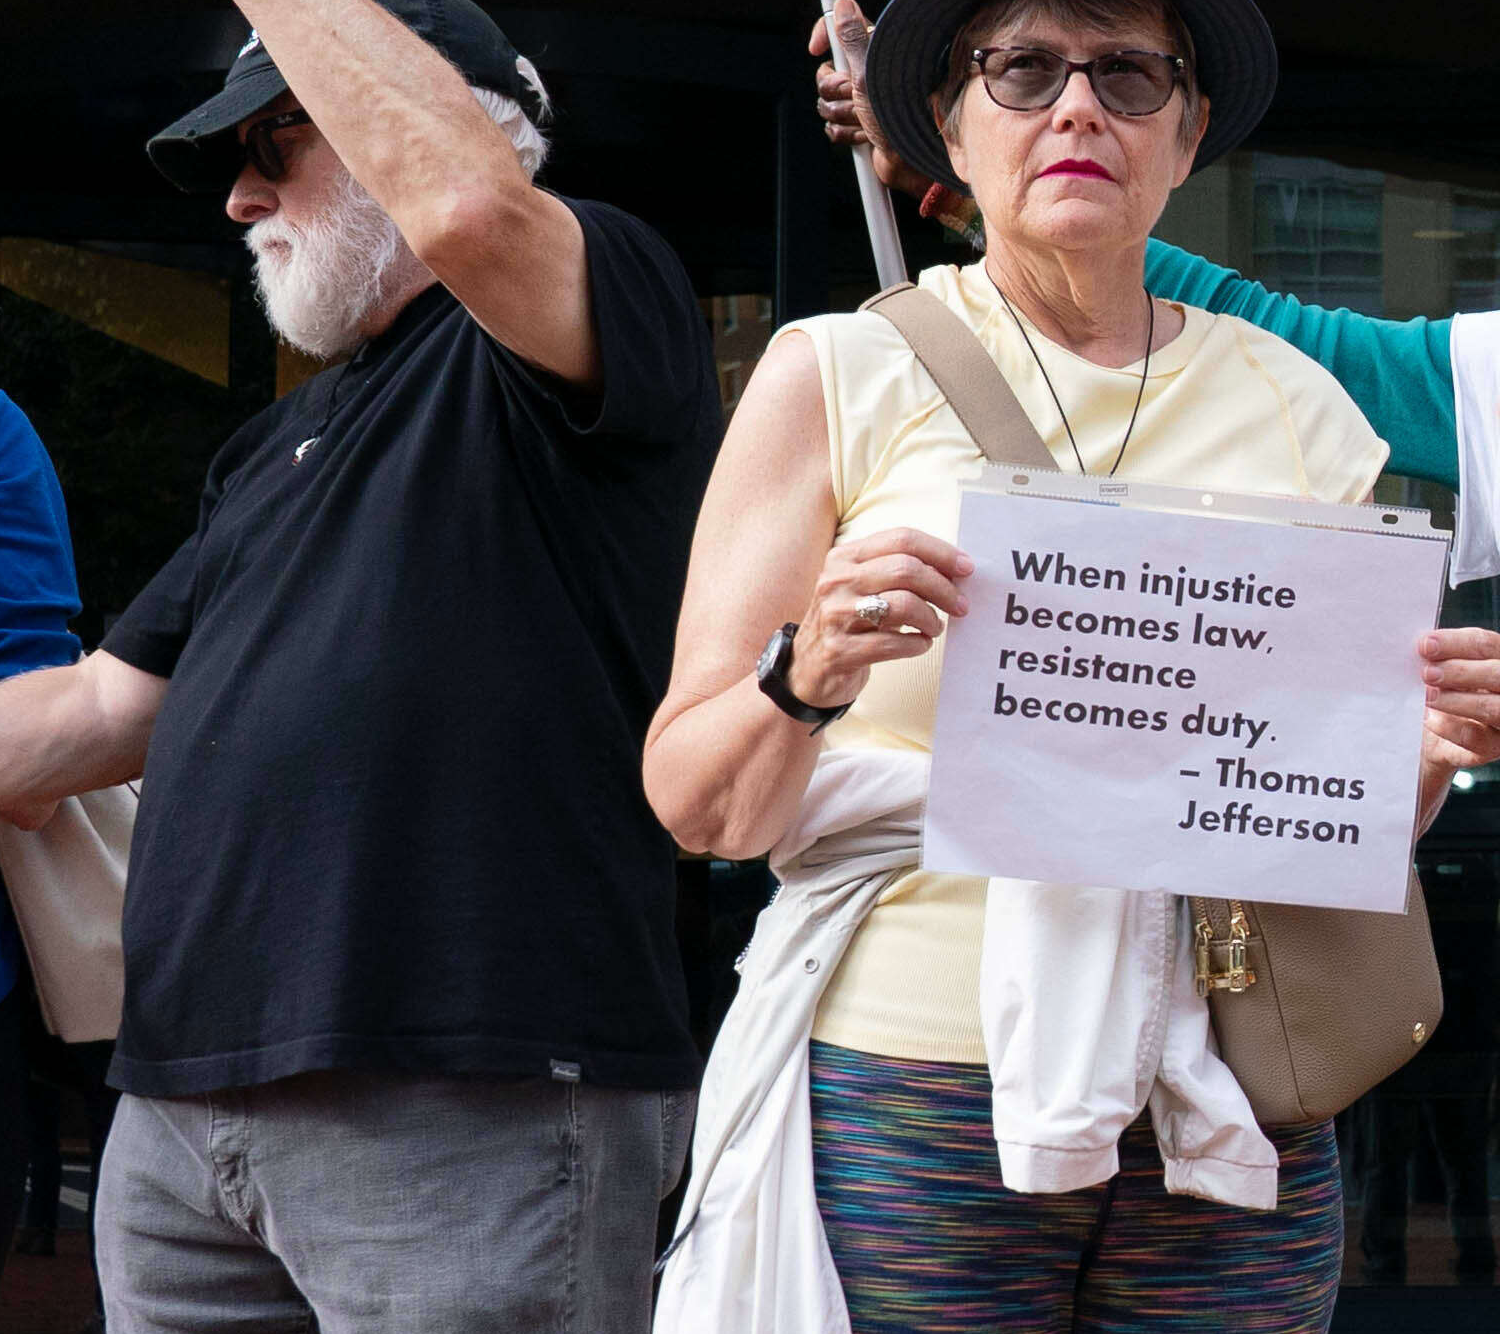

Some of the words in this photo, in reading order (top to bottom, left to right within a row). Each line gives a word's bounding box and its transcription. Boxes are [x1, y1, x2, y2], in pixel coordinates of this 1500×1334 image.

[1011, 549, 1126, 592] When
[1139, 561, 1296, 609] injustice
[1004, 592, 1180, 643] becomes
[1192, 612, 1274, 655] law,
[998, 645, 1197, 690] resistance
[993, 682, 1169, 732] becomes
[1181, 702, 1277, 749] duty.
[1215, 756, 1365, 801] Thomas
[1177, 799, 1360, 846] Jefferson
